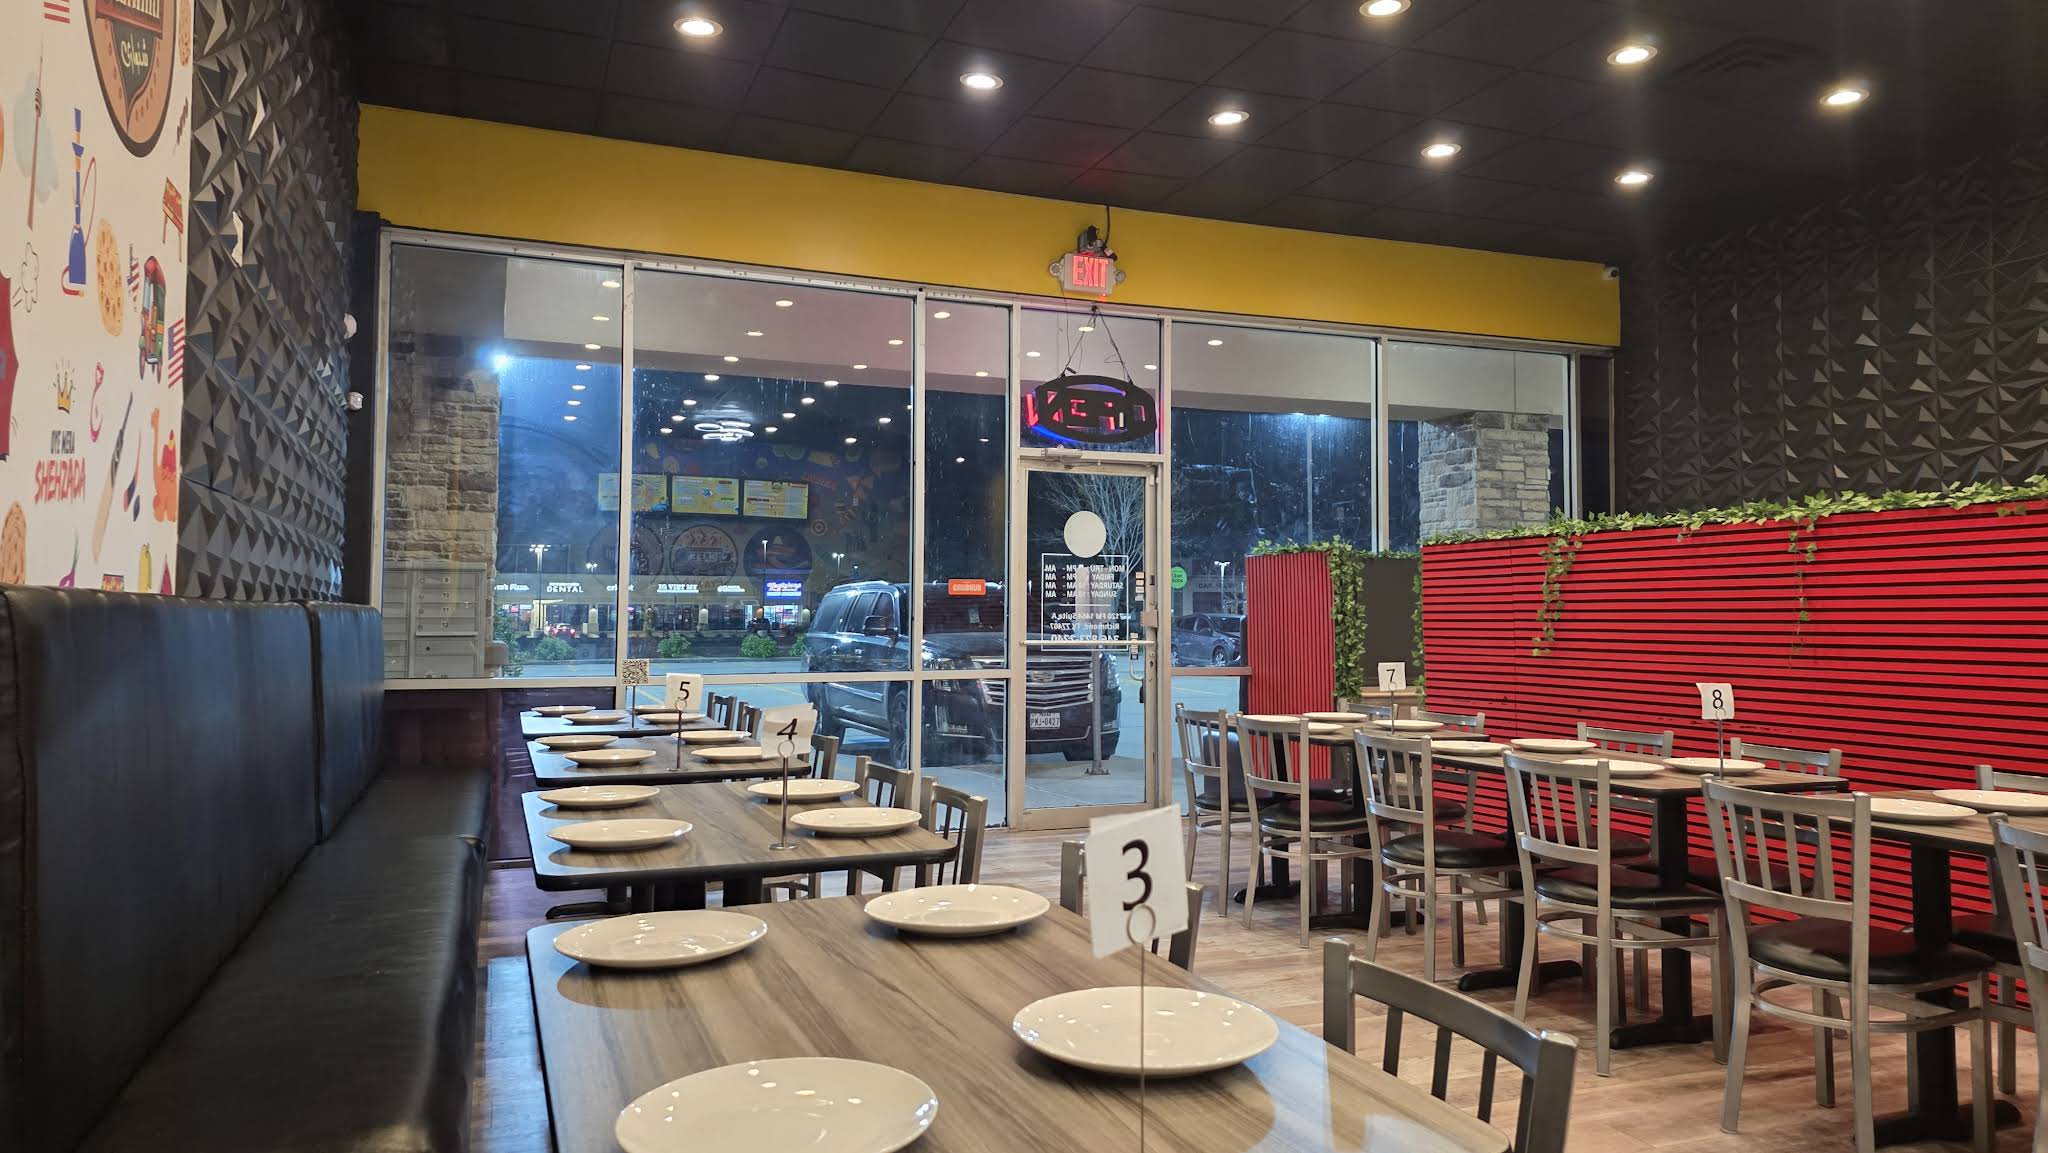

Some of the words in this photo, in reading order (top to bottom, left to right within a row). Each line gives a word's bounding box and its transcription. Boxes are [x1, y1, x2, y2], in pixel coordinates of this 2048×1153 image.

[1073, 256, 1109, 288] EXIT
[35, 458, 86, 504] SHEHZADA
[547, 585, 584, 593] DENTAL
[1386, 668, 1396, 682] 7
[677, 681, 691, 700] 5
[1712, 689, 1724, 709] 8
[776, 718, 798, 740] 4
[1122, 839, 1152, 911] 3
